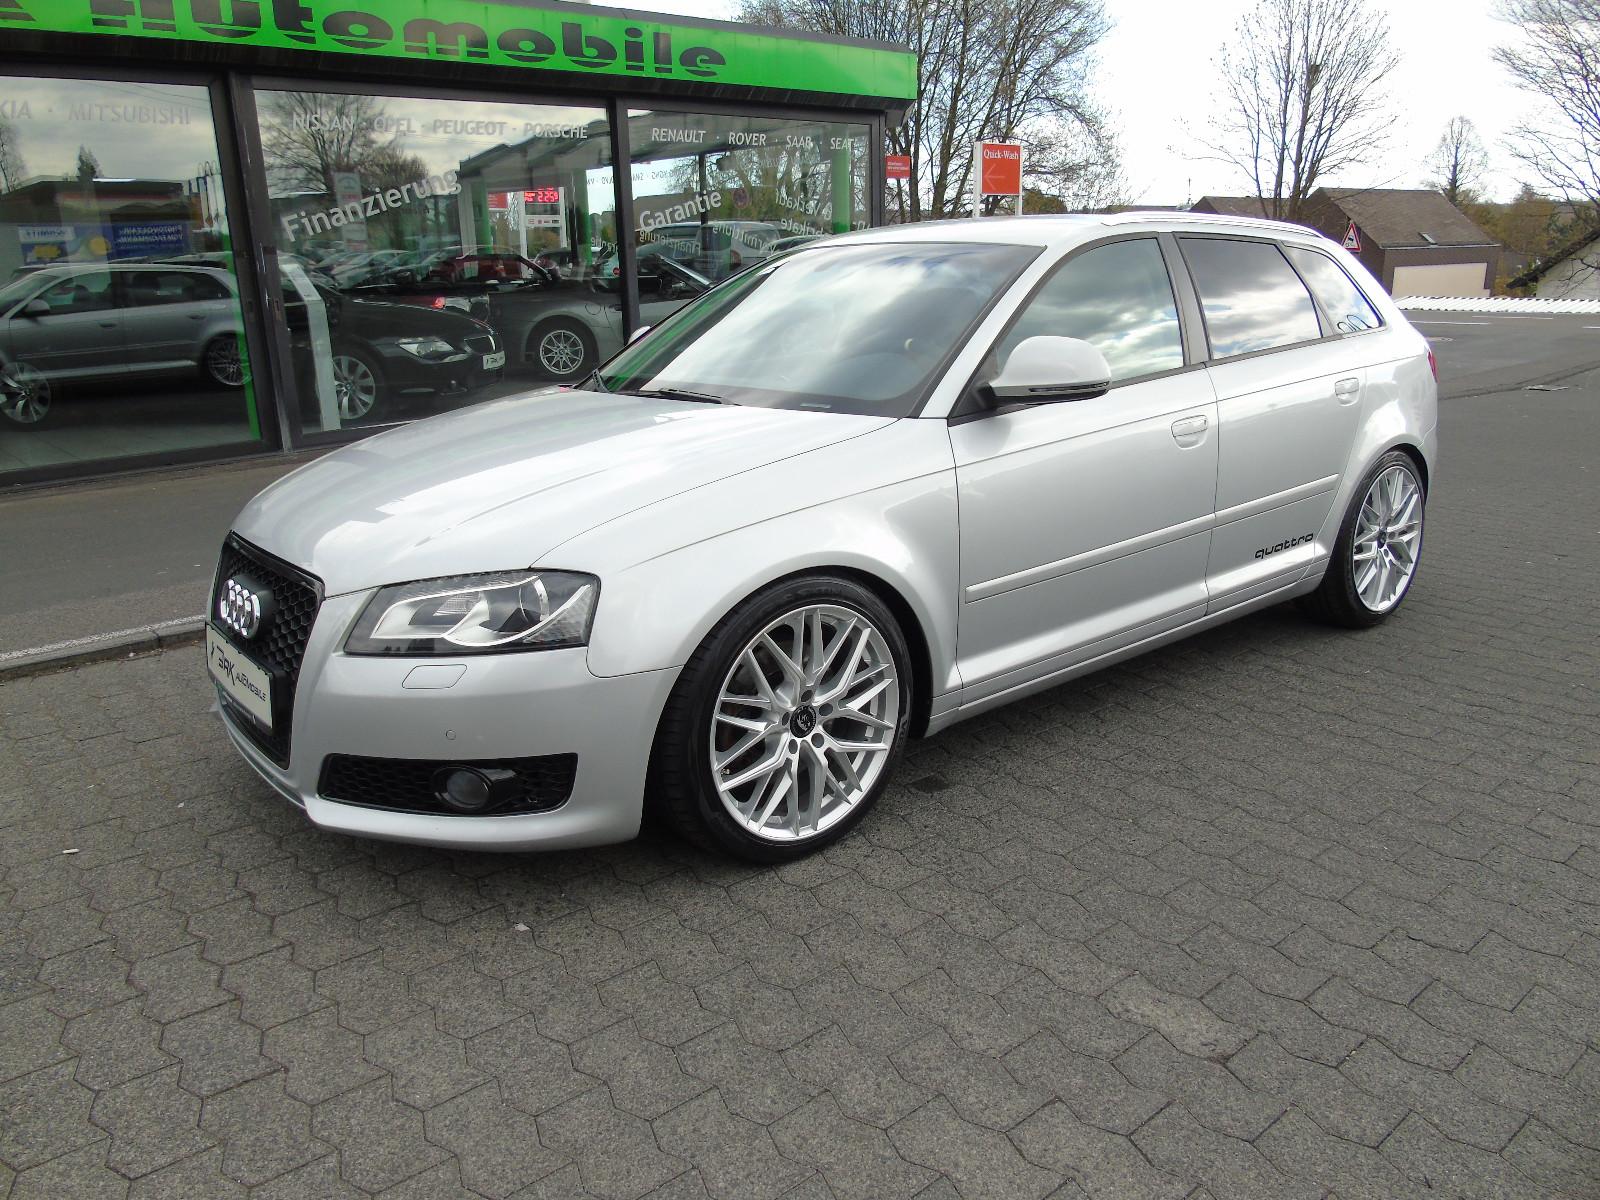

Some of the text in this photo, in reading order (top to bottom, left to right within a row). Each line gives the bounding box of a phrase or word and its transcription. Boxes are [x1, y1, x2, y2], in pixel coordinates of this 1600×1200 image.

[68, 103, 192, 124] MITSUBISHI
[292, 113, 588, 139] NISSAN OPEL PEUGEOT PORSCHE
[651, 127, 853, 150] RENAULT ROVER SAAB SEAT
[983, 149, 1019, 160] Quick-Wash
[280, 168, 462, 242] Finanzierung
[639, 189, 722, 232] Garantie
[1254, 532, 1314, 560] quattro
